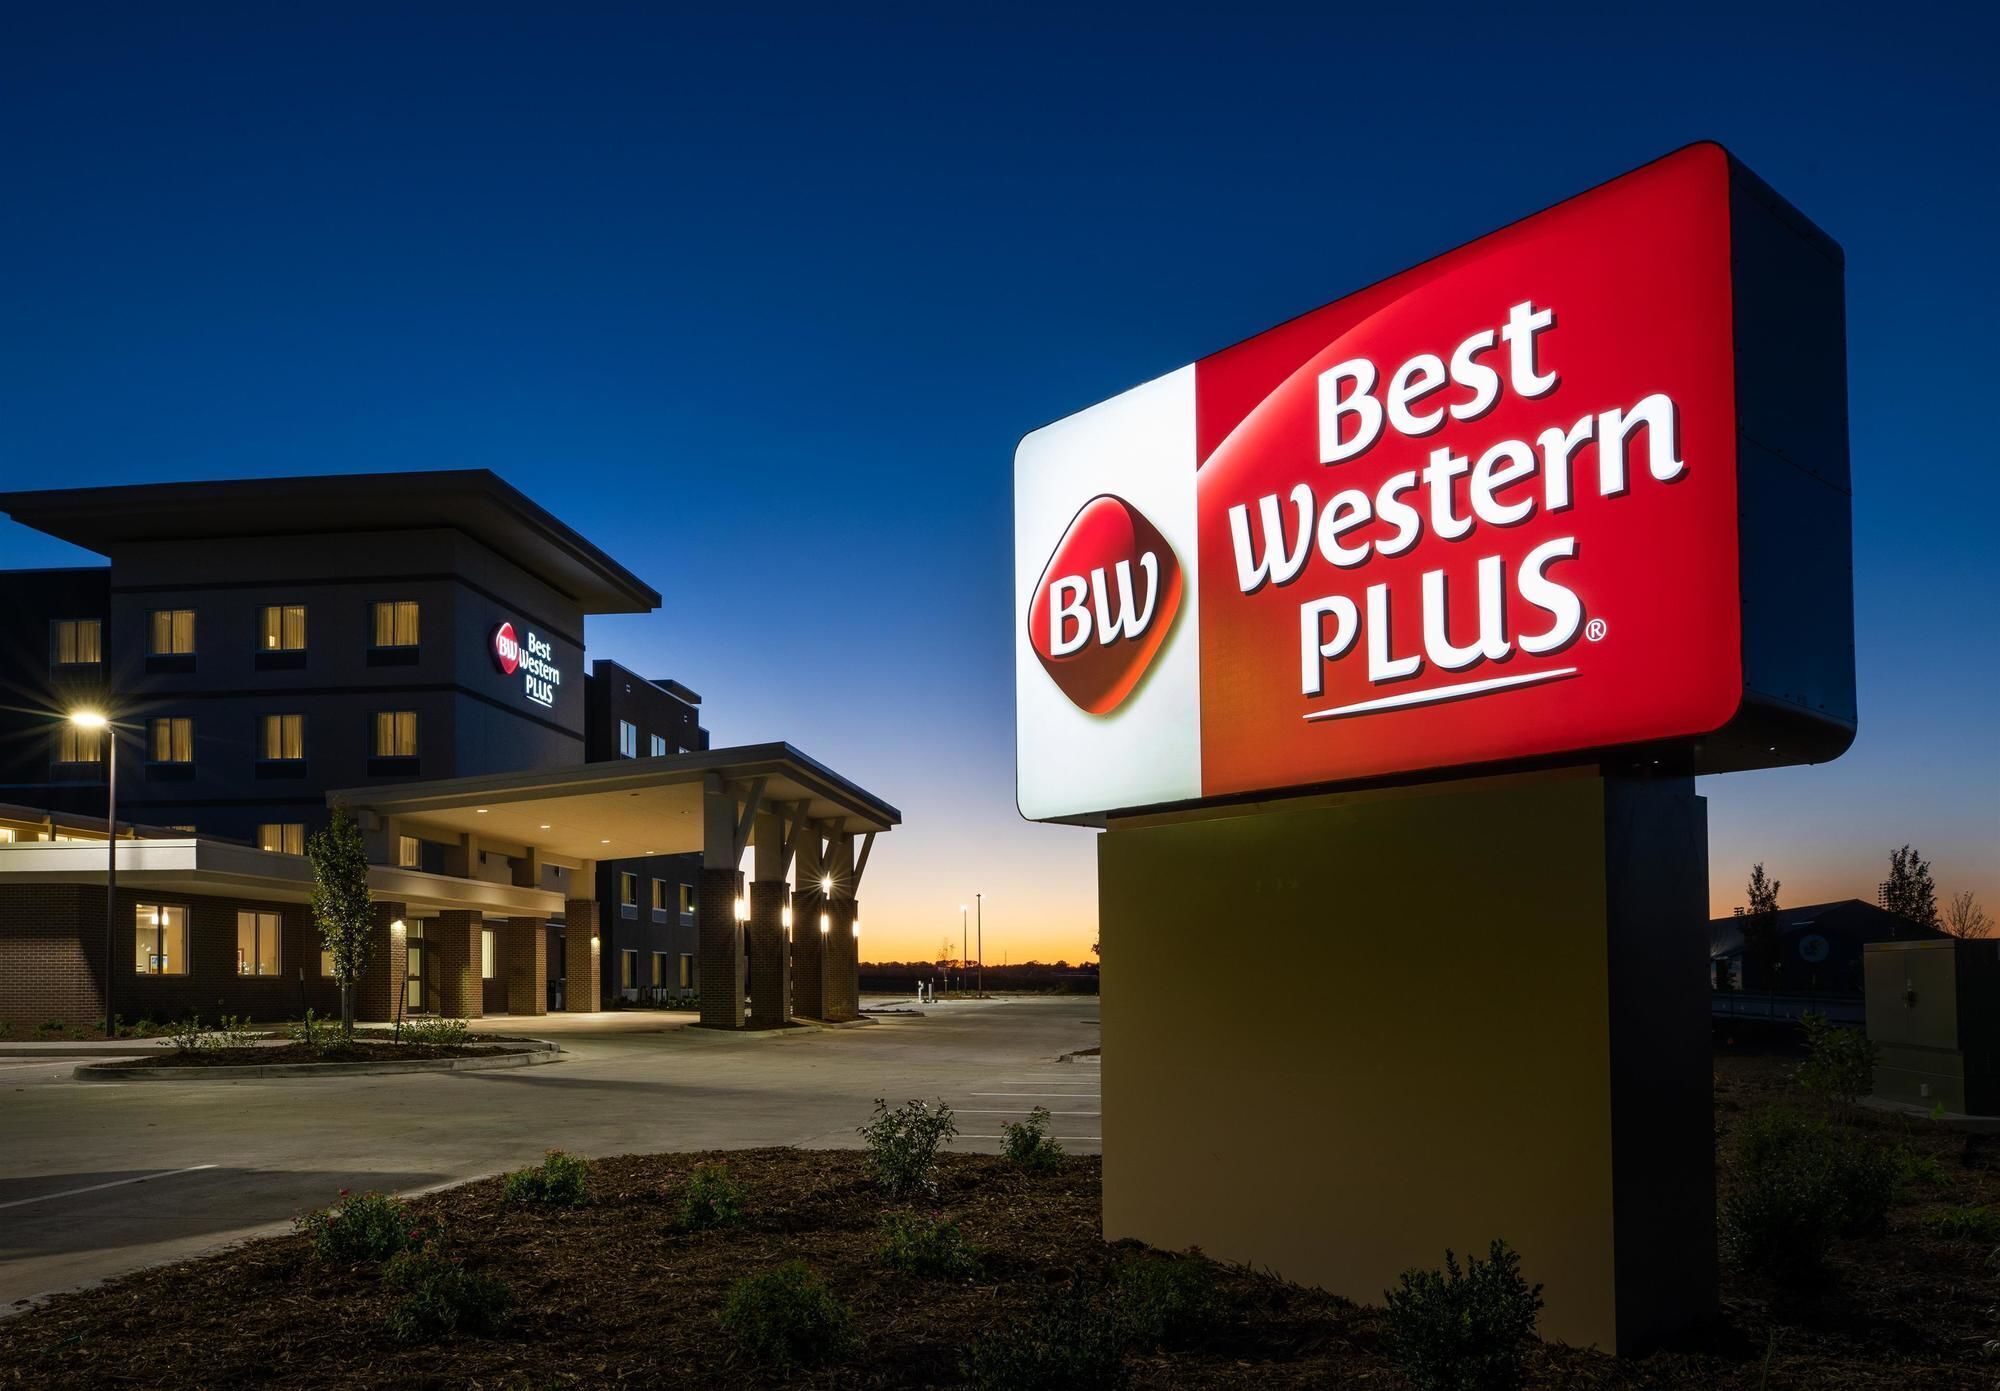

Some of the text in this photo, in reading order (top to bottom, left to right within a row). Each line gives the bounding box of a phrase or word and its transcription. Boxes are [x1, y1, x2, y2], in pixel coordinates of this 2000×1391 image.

[1318, 300, 1558, 464] Best
[1229, 394, 1684, 593] Western
[1049, 551, 1158, 657] BW
[1302, 537, 1582, 694] PLUS
[499, 635, 518, 661] BW
[519, 647, 560, 686] Western
[528, 631, 551, 662] Best
[526, 674, 553, 704] PLUS
